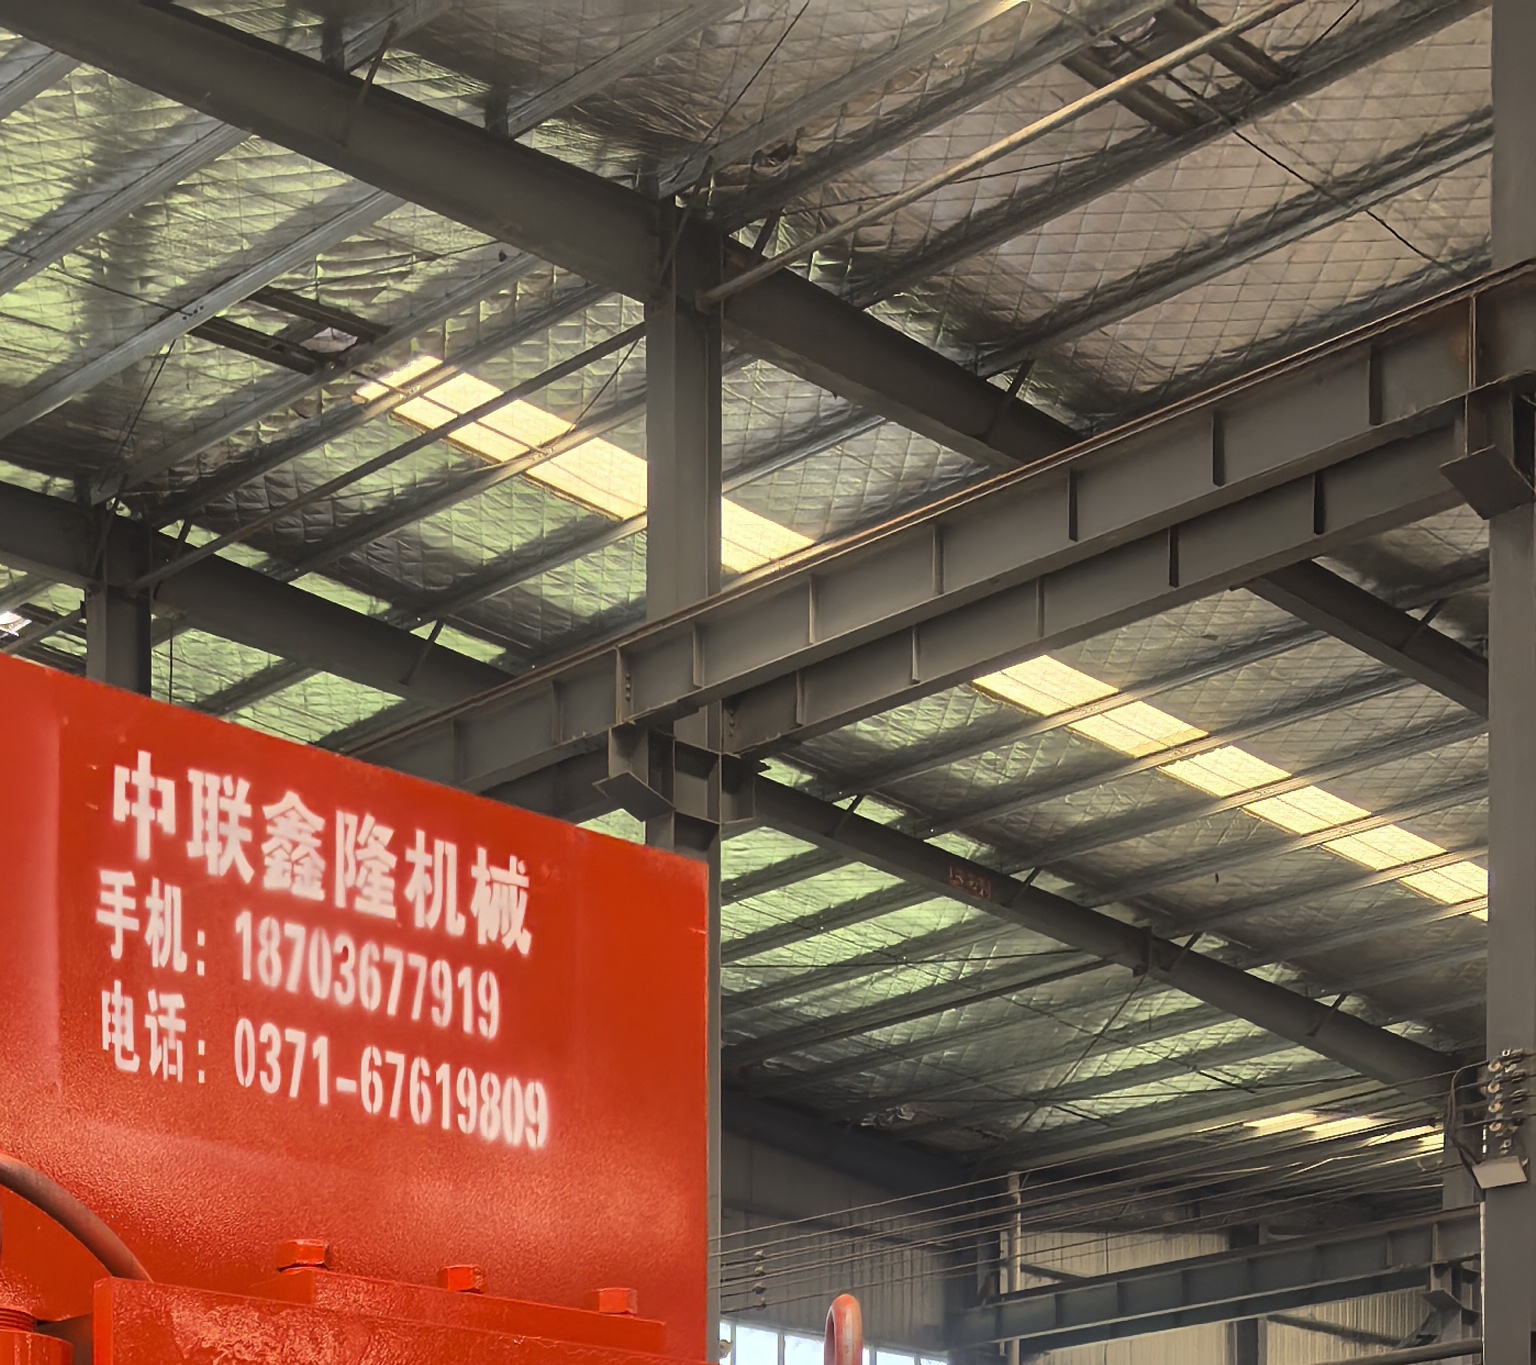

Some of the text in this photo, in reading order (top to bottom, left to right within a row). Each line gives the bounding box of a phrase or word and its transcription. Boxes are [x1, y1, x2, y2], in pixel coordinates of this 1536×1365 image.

[112, 750, 533, 957] 中联鑫隆机械
[95, 869, 501, 1041] 手机： 18703677919
[101, 979, 551, 1150] 电话： 0371-67619809
